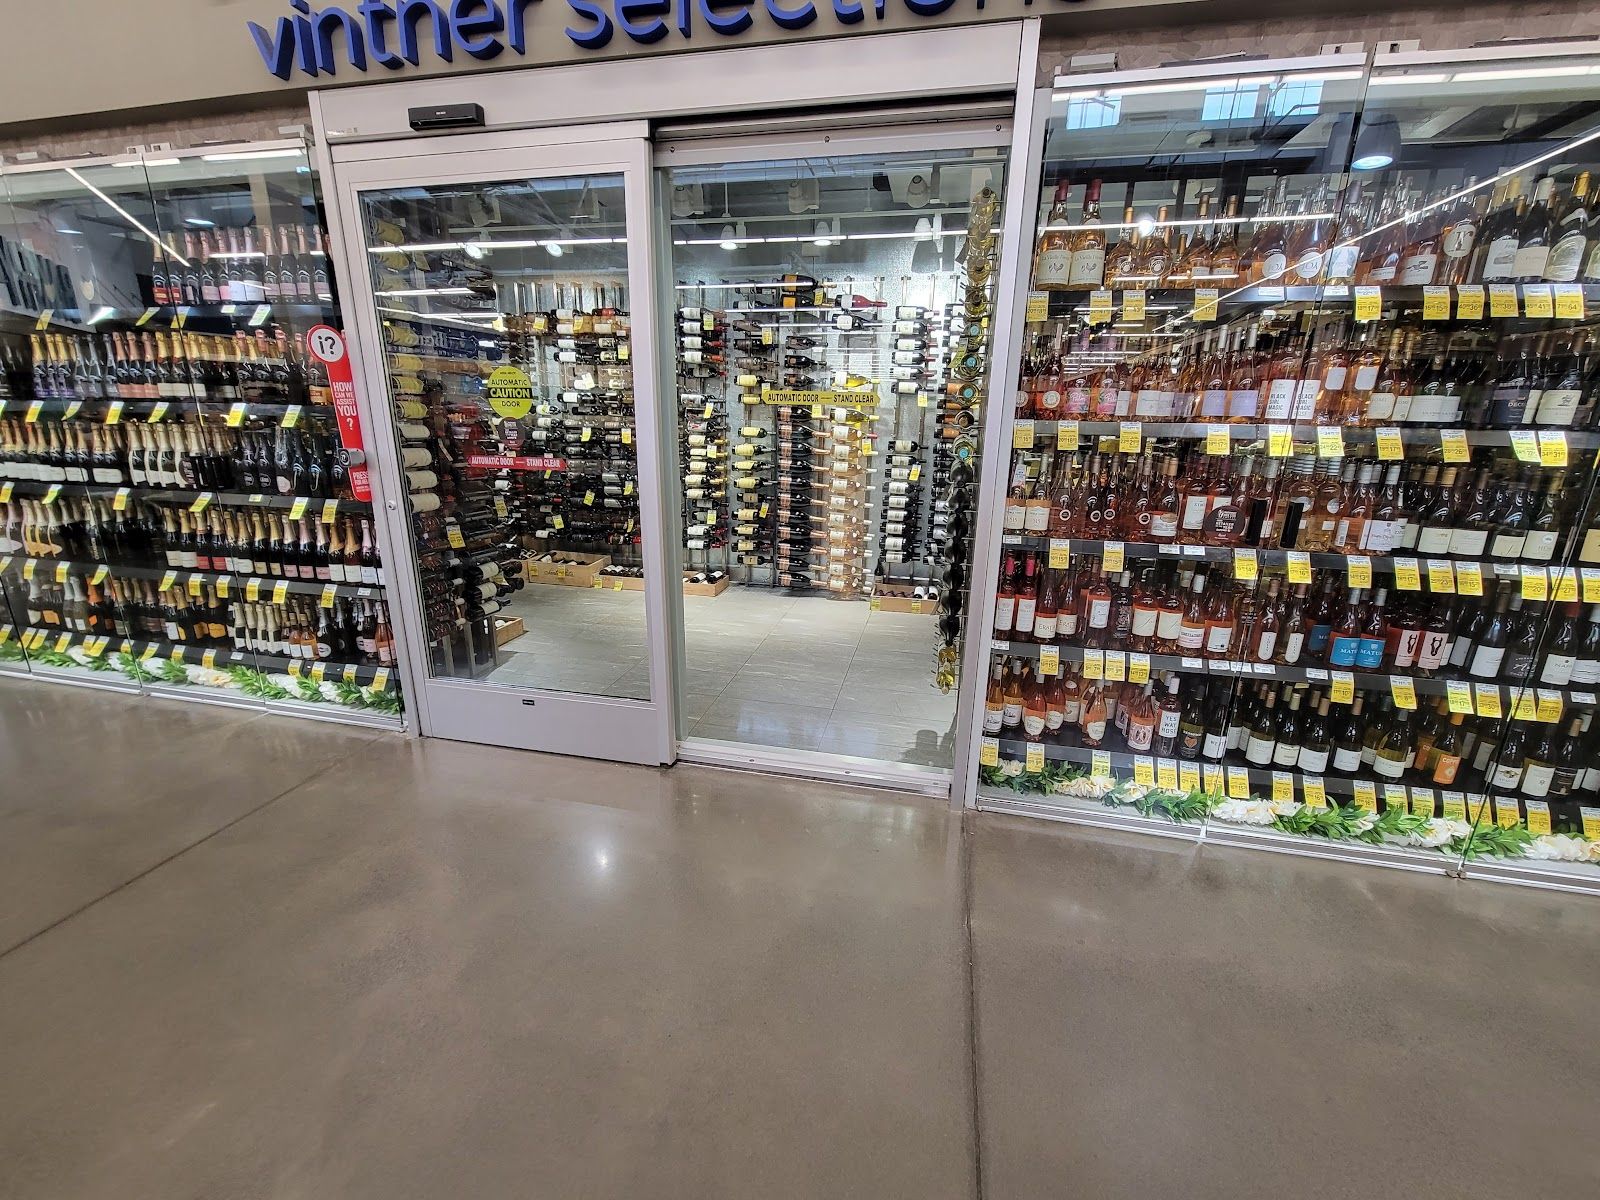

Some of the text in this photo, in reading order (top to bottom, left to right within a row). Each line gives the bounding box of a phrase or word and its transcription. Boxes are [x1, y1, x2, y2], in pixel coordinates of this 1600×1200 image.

[247, 0, 543, 81] vintner
[333, 381, 352, 392] HOW
[490, 388, 530, 398] CAUTION
[767, 393, 801, 402] AUTOMATIC
[802, 394, 819, 402] DOOR
[833, 394, 853, 403] STAND
[854, 394, 874, 403] CLEAR
[337, 405, 357, 417] YOU
[471, 456, 500, 465] AUTOMATIC
[526, 458, 543, 467] STAND
[543, 459, 560, 468] CLEAR
